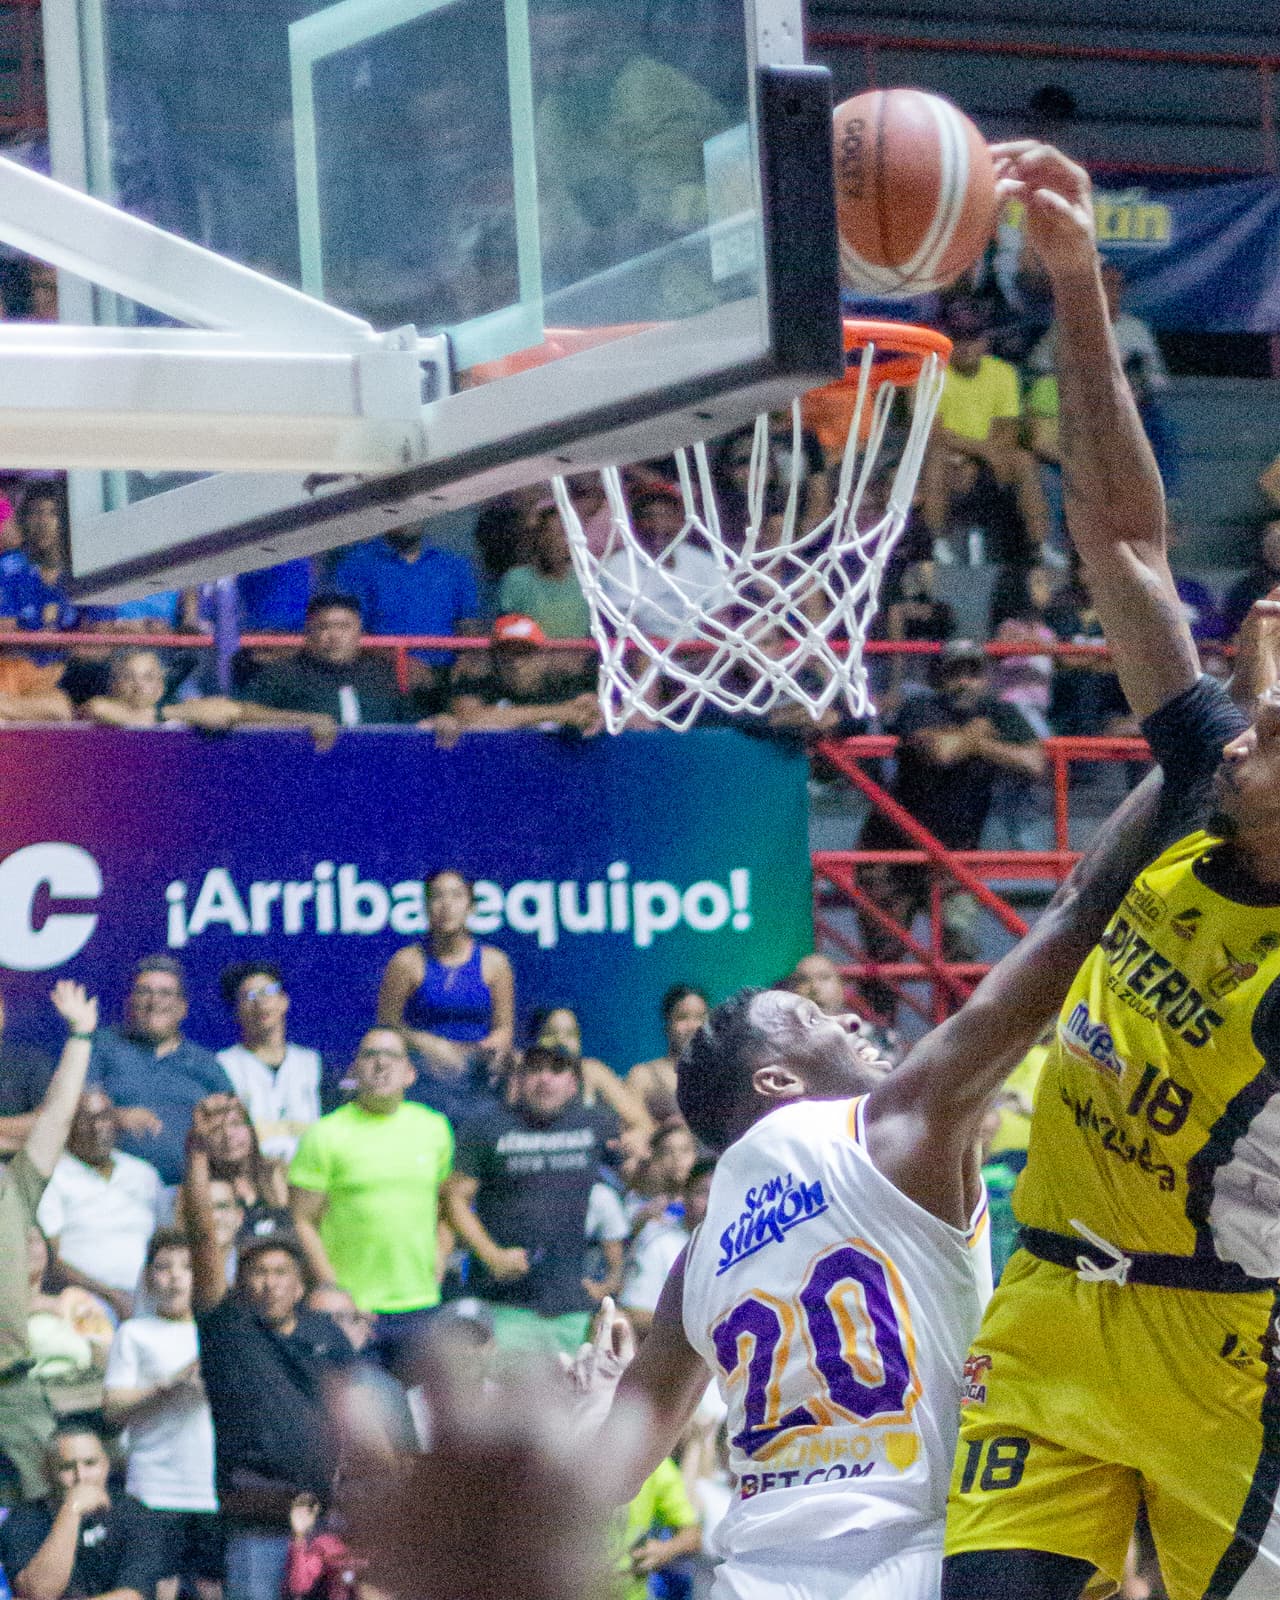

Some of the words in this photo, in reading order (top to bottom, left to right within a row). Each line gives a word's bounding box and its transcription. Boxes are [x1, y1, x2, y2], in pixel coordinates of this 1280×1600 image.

[165, 862, 427, 948] ¡Arriba
[473, 862, 752, 948] equipo!
[1126, 1062, 1193, 1136] 18
[711, 1238, 919, 1457] 20
[960, 1437, 1031, 1494] 18
